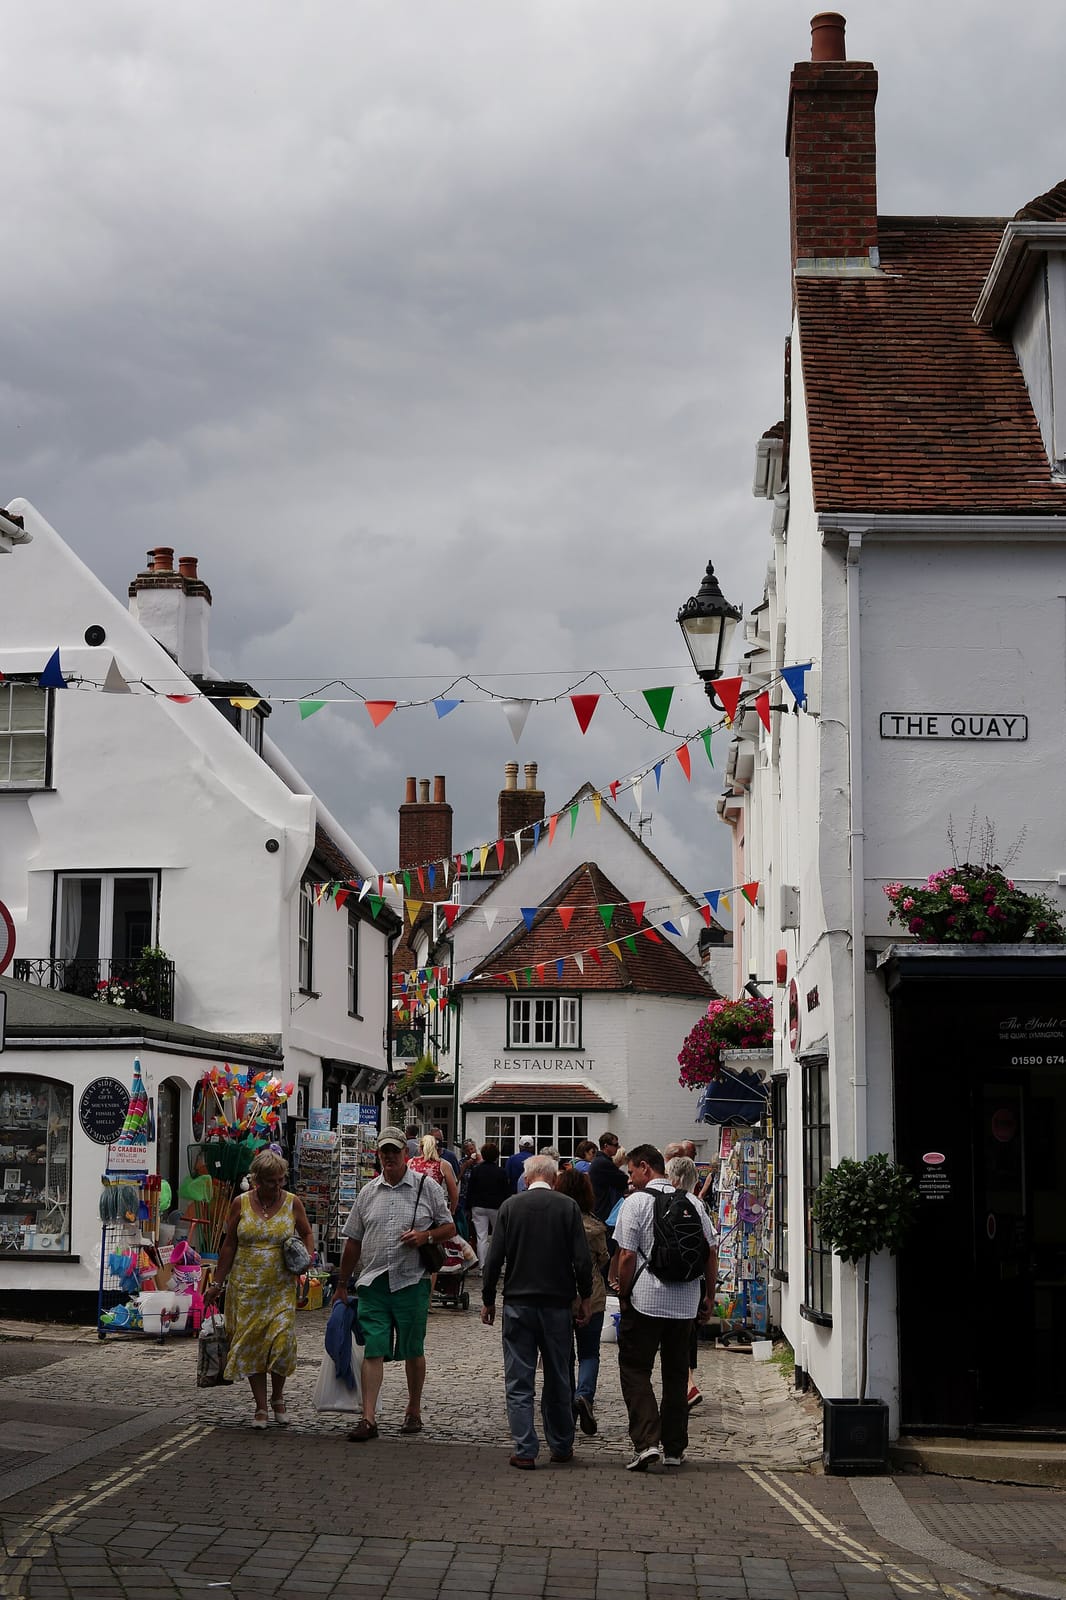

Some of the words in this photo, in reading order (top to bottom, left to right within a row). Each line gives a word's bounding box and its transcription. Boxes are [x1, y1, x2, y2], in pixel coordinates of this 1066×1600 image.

[890, 716, 938, 735] THE
[951, 717, 1017, 736] QUAY
[494, 1059, 596, 1070] RESTAURANT
[1011, 1056, 1043, 1065] 01590
[1046, 1056, 1066, 1065] 674
[82, 1085, 97, 1106] QUAY
[97, 1080, 113, 1088] SIDE
[114, 1085, 129, 1106] GIFTS
